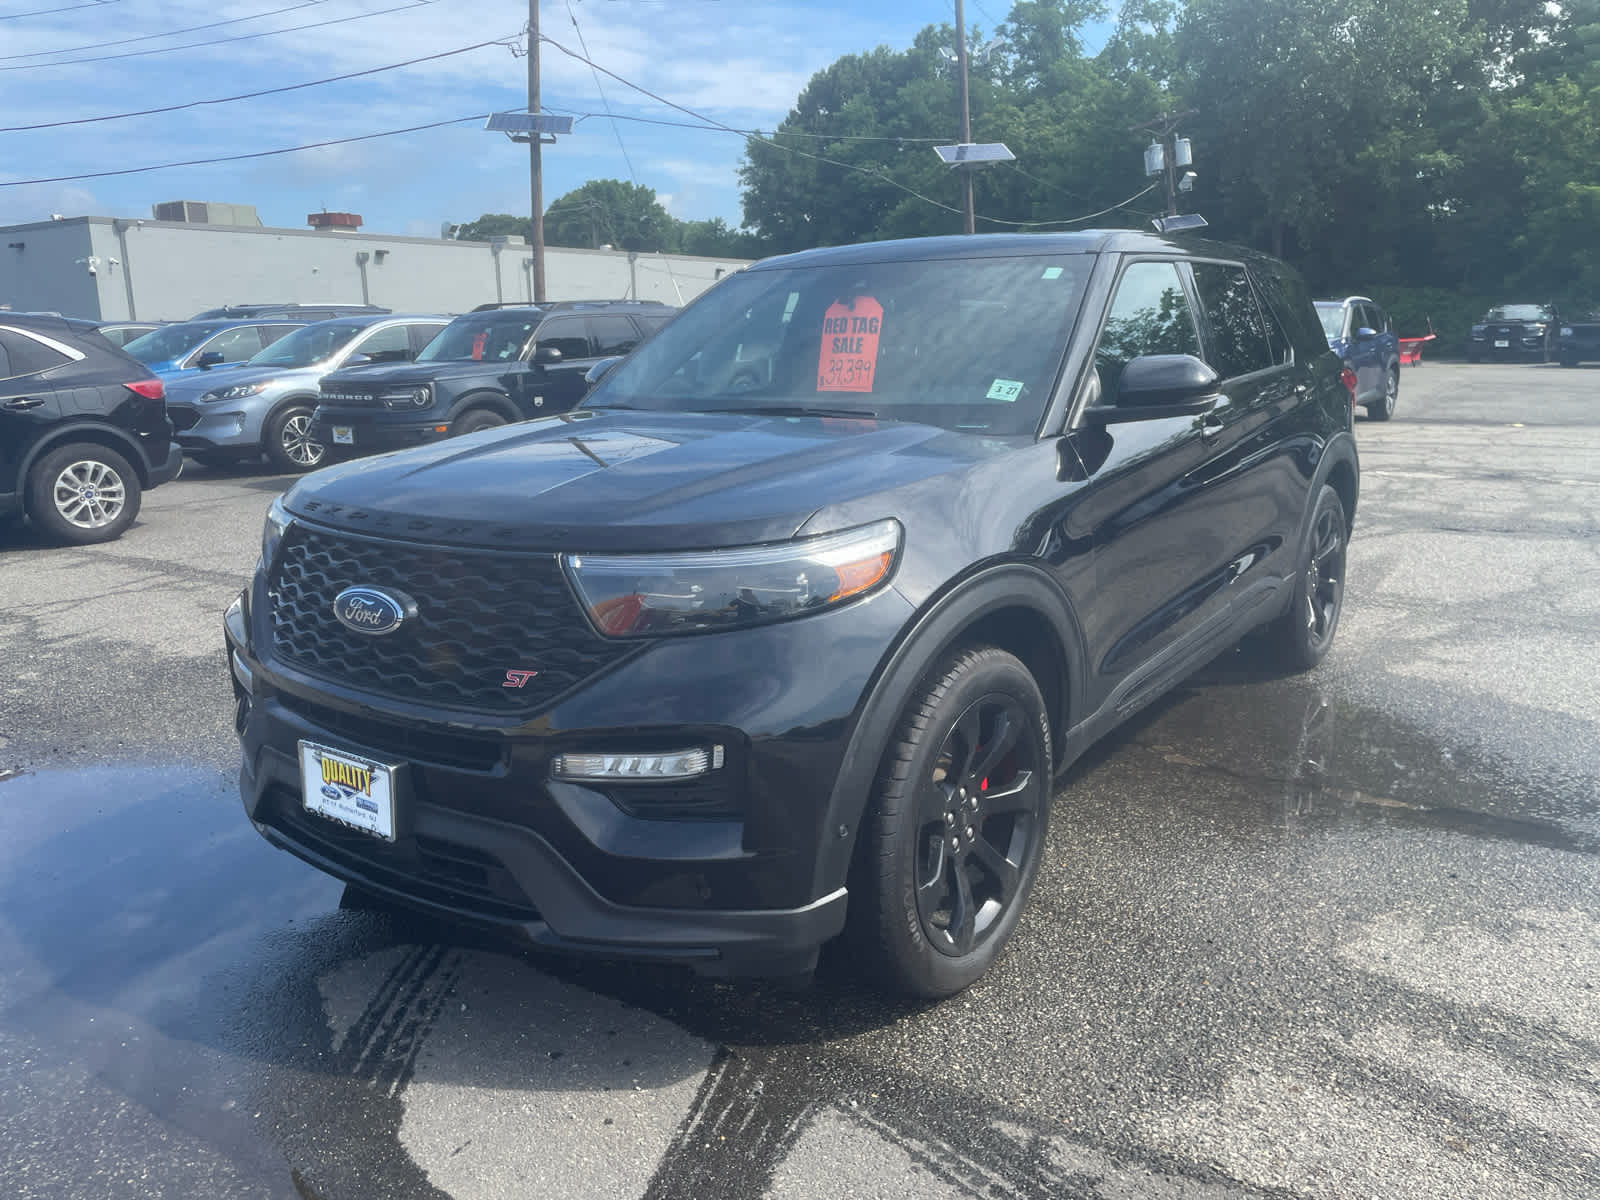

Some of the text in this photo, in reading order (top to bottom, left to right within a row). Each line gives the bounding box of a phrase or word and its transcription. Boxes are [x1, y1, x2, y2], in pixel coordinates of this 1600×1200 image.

[824, 316, 880, 335] RED TAG
[832, 336, 864, 355] SALE
[345, 596, 384, 626] Ford
[502, 669, 539, 688] ST
[320, 757, 371, 797] QUALITY
